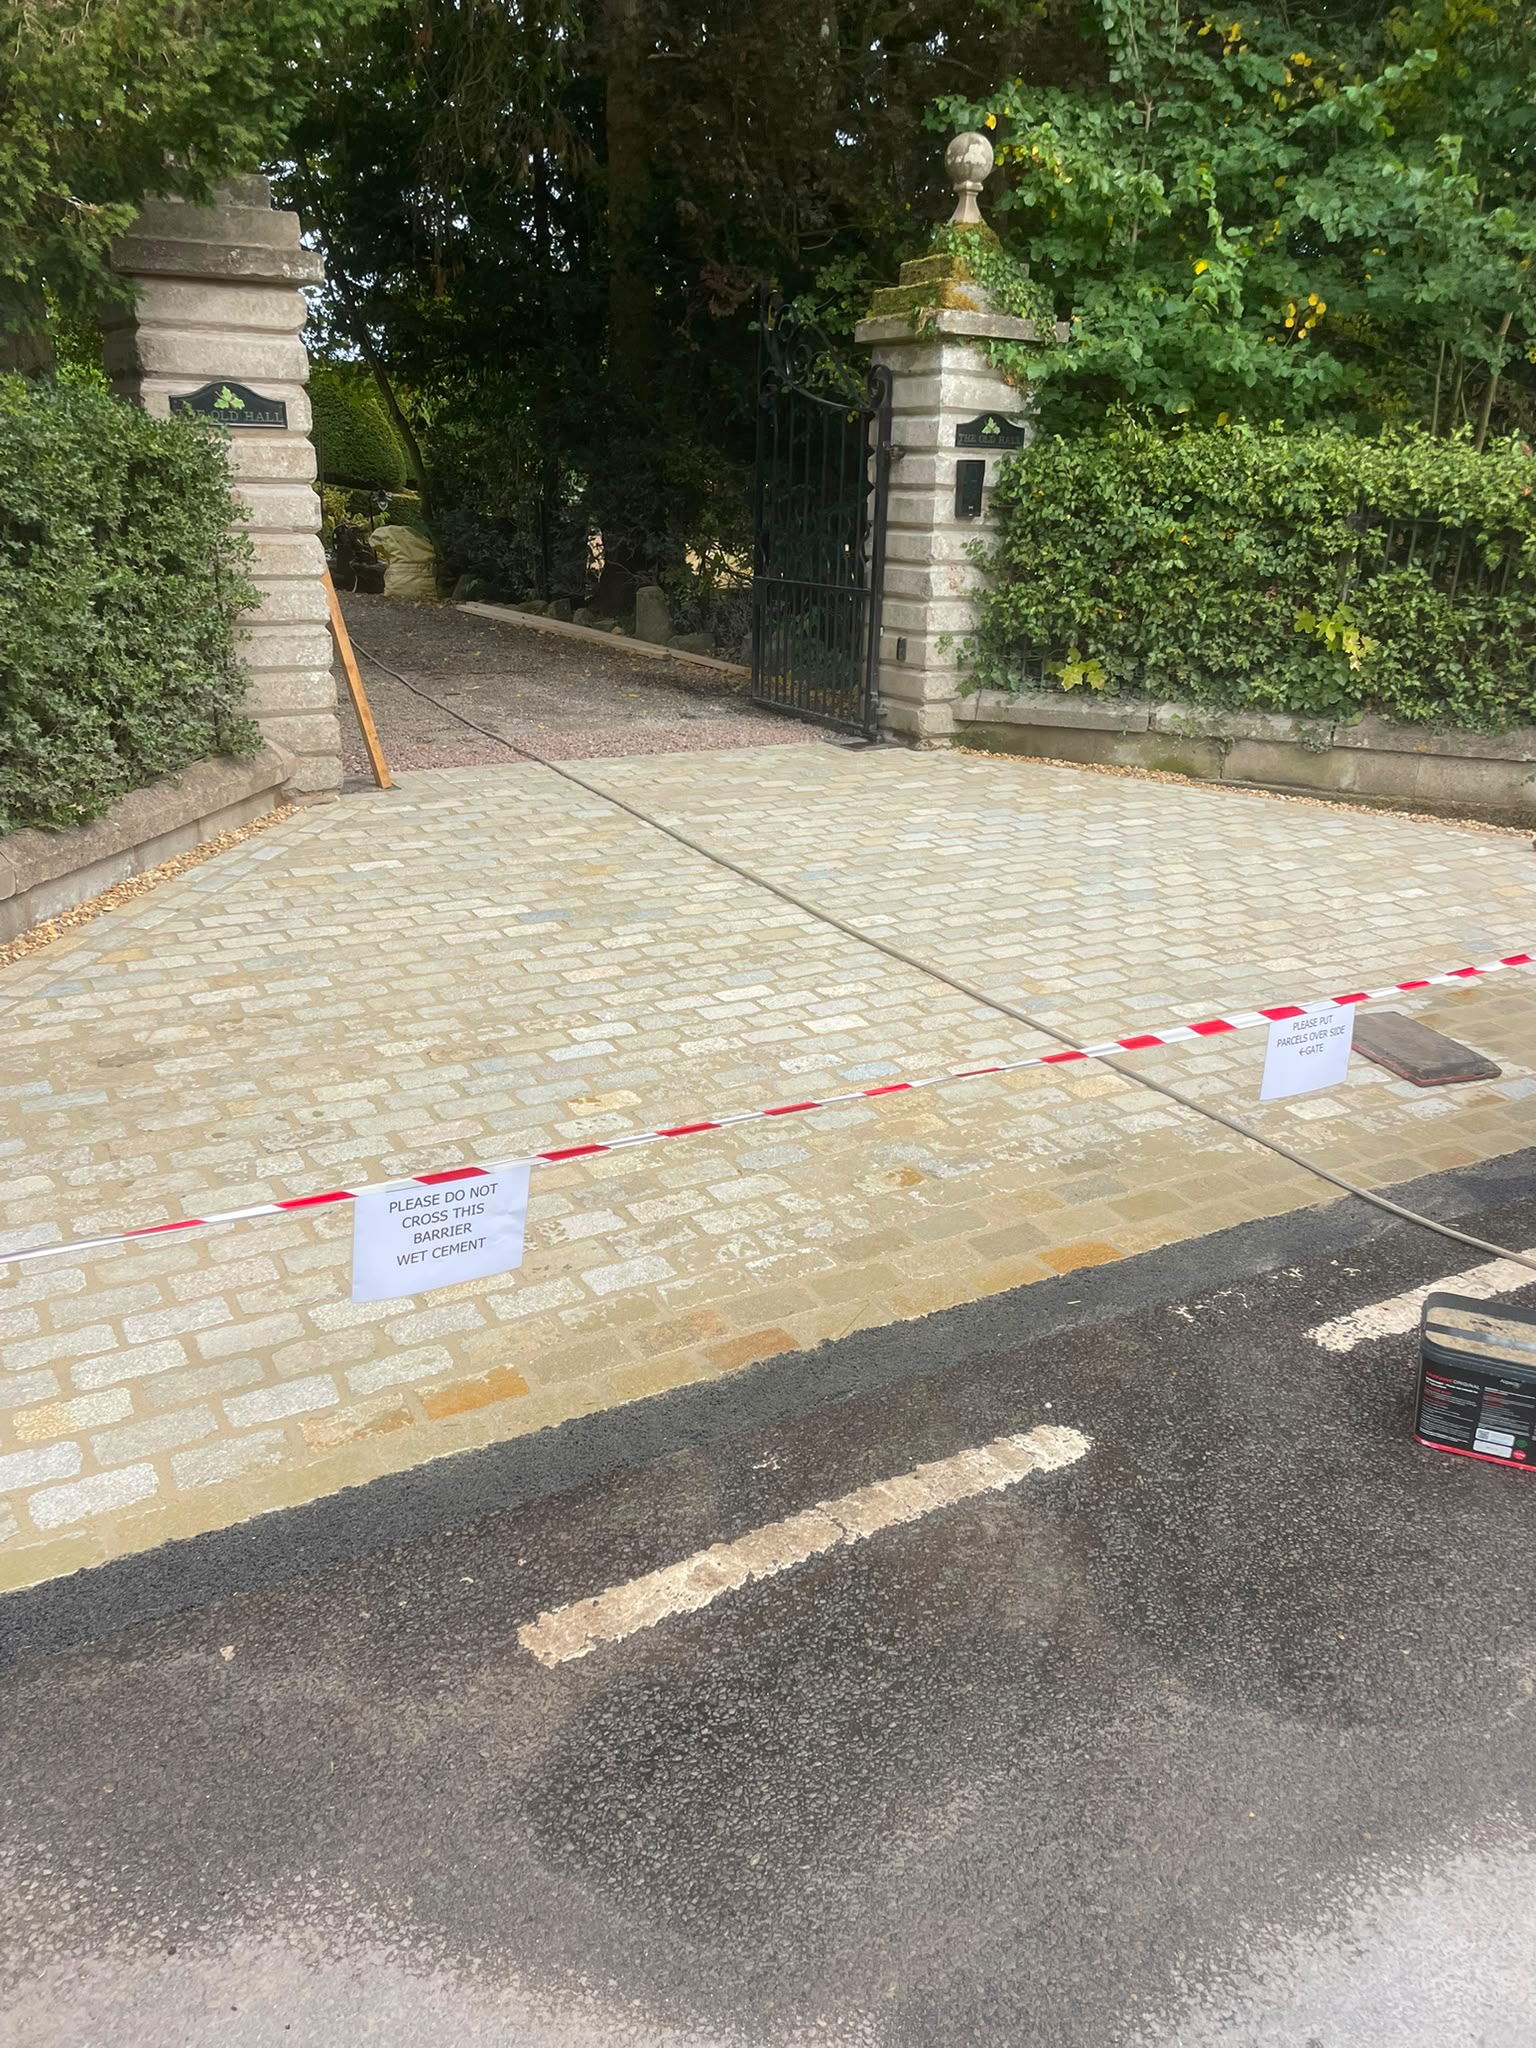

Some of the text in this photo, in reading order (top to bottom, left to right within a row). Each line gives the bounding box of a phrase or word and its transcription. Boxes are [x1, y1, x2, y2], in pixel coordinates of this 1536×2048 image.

[175, 409, 284, 423] TE OLD HALL
[1293, 1015, 1333, 1031] PLEASE PUT
[1277, 1025, 1345, 1047] PARCELS OVER SIDE
[1305, 1043, 1324, 1055] GATE
[389, 1183, 498, 1213] PLEASE DO NOT
[402, 1203, 485, 1229] CROSS THIS
[413, 1222, 472, 1244] BARRIER
[397, 1237, 487, 1266] WET CEMENT
